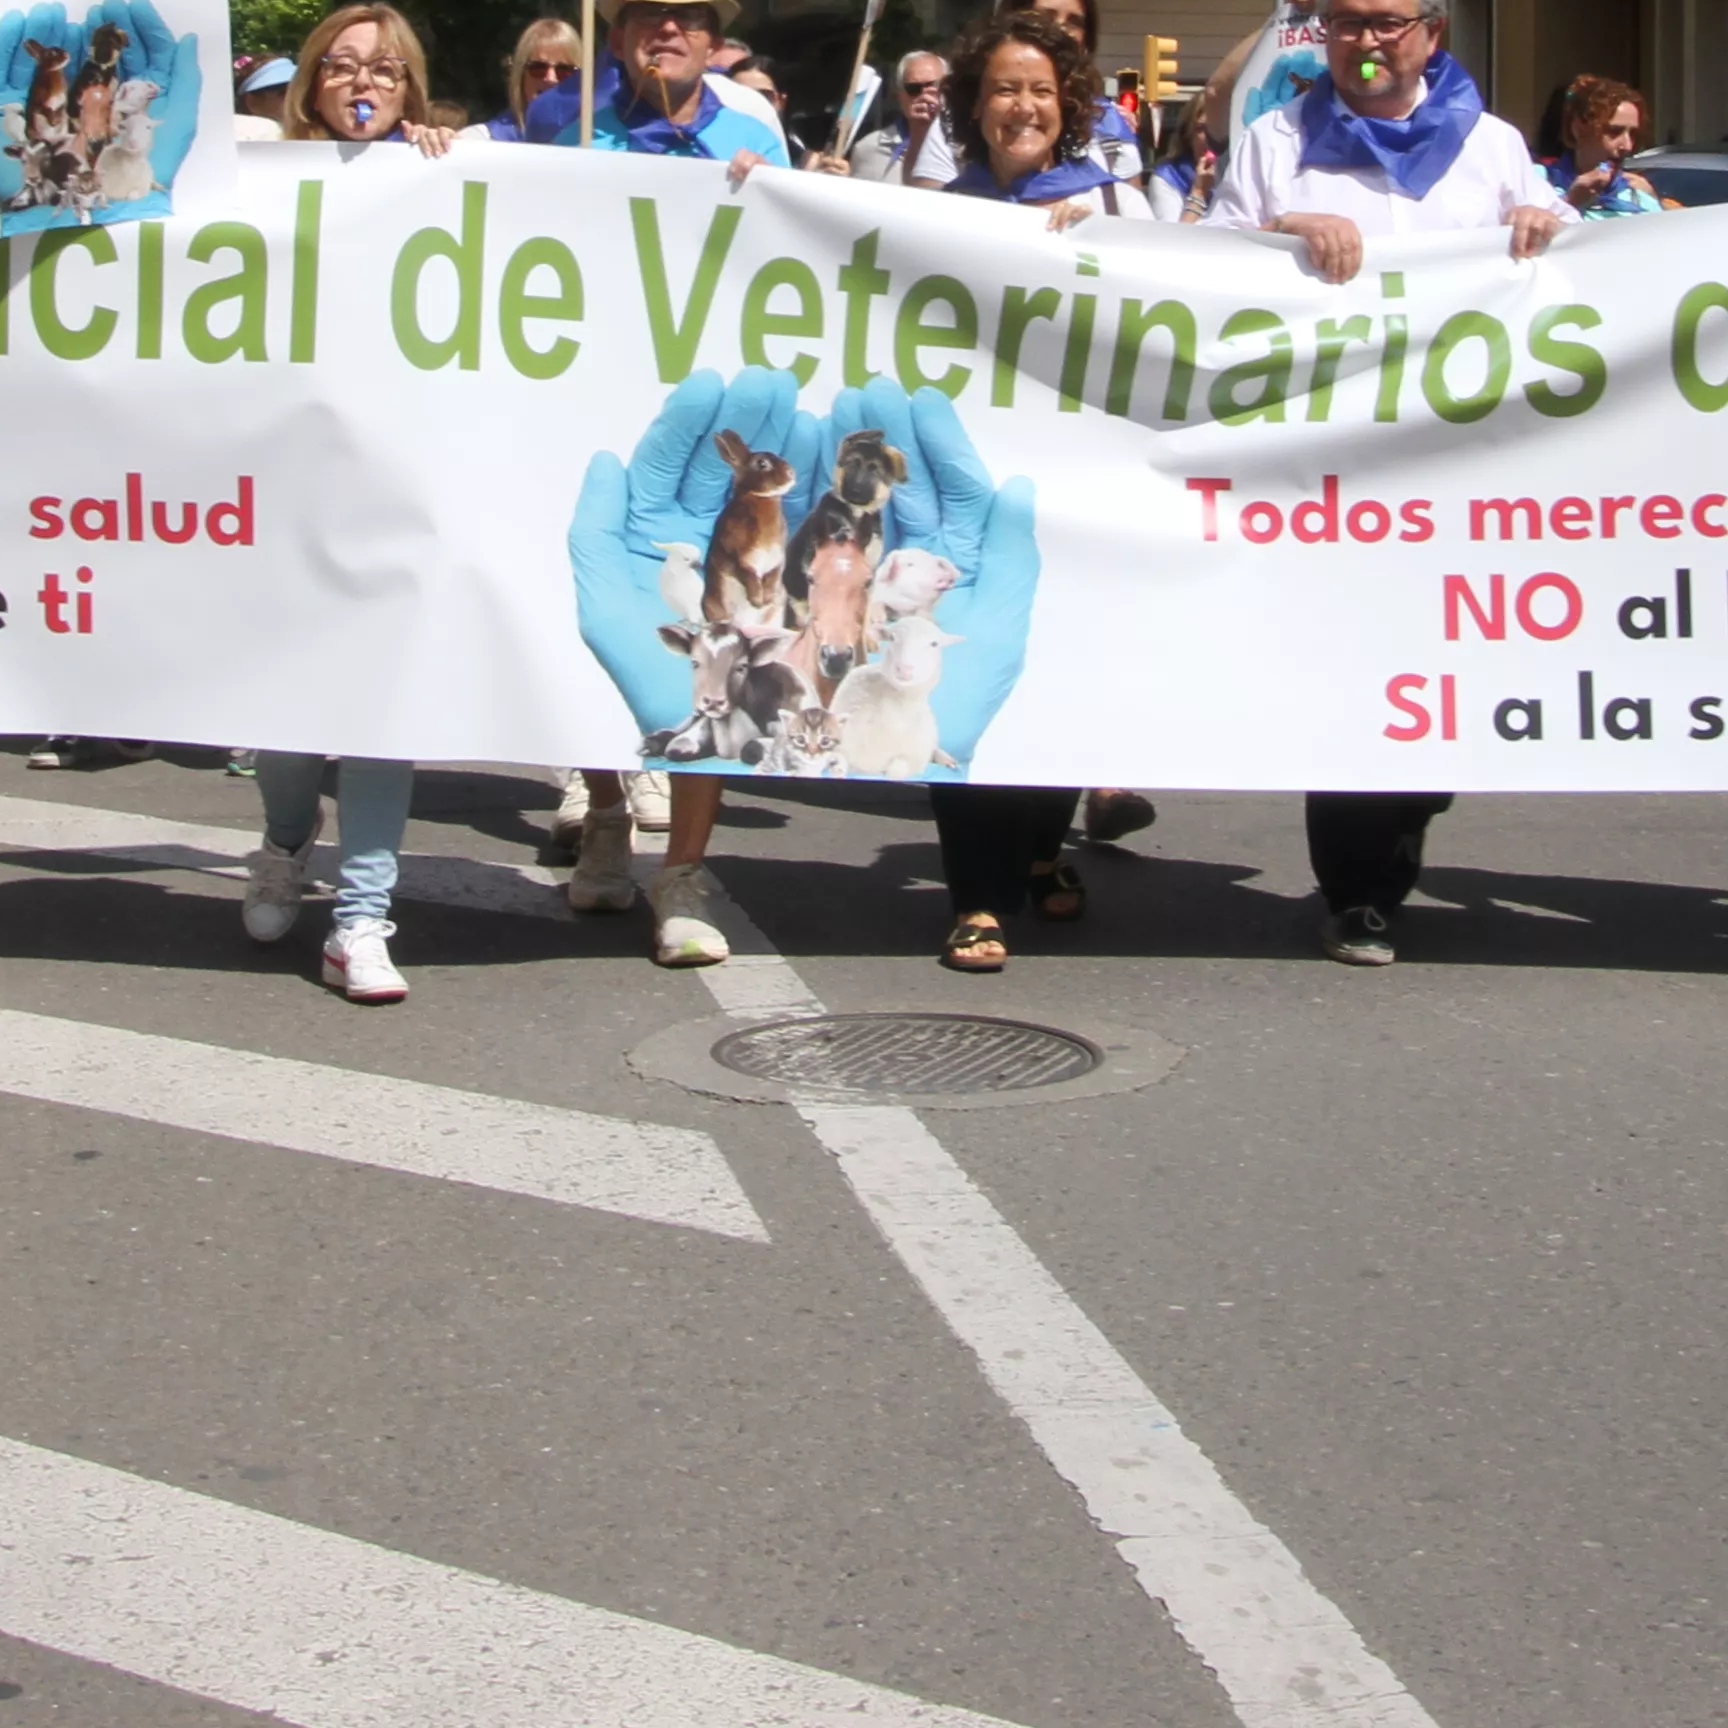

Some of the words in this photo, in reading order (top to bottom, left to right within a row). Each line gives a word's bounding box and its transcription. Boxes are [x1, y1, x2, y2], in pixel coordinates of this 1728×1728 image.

[390, 180, 586, 380] de
[628, 196, 1607, 427] Veterinarios
[28, 472, 255, 546] salud
[1185, 475, 1434, 544] Todos
[37, 565, 94, 634] ti
[1442, 572, 1584, 641] NO
[1616, 568, 1692, 639] al
[1383, 673, 1457, 742] SI
[1492, 696, 1544, 741] a
[1577, 670, 1653, 741] la
